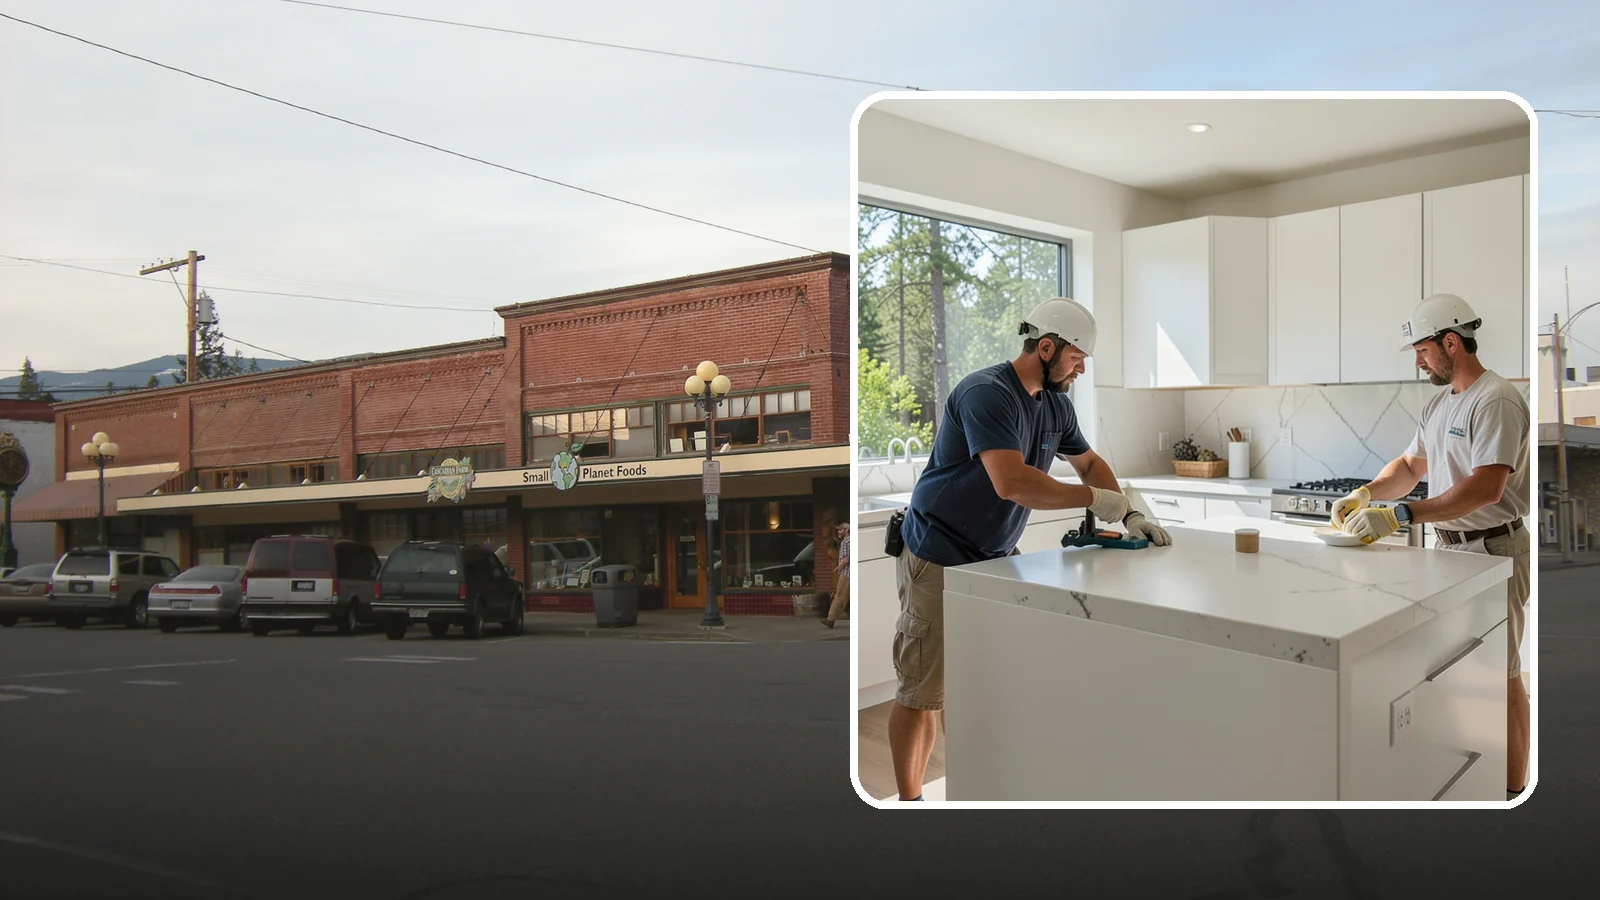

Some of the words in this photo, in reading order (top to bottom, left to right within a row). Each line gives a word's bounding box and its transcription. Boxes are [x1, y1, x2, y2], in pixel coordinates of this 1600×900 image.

[523, 471, 549, 483] Small
[583, 467, 614, 479] Planet
[617, 464, 647, 477] Foods
